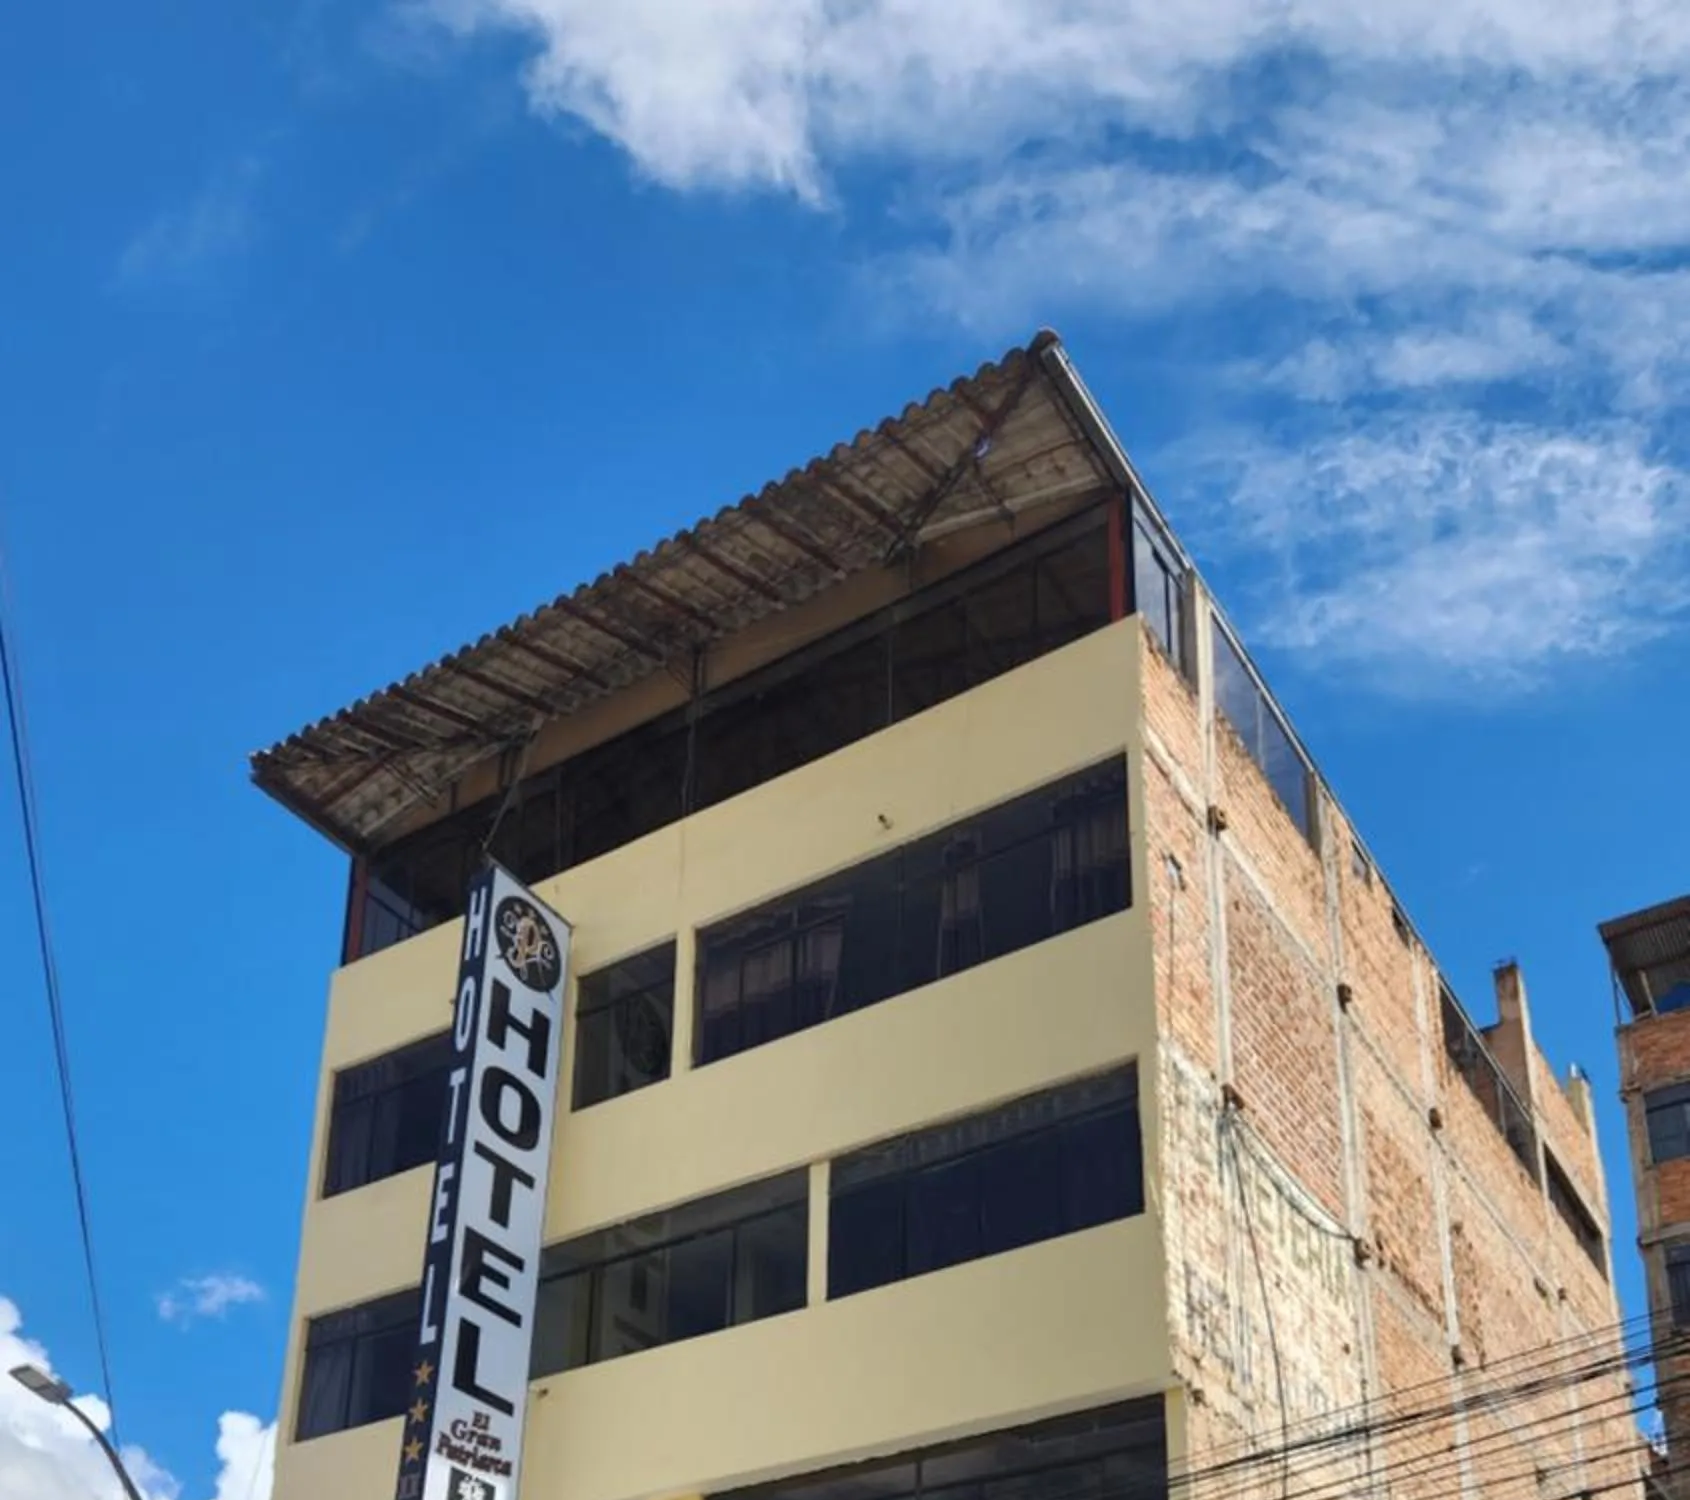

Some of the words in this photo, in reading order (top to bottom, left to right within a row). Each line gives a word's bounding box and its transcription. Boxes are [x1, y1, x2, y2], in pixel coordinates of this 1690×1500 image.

[420, 887, 487, 1345] HOTEL
[452, 977, 551, 1417] HOTEL
[450, 1418, 502, 1452] Gran
